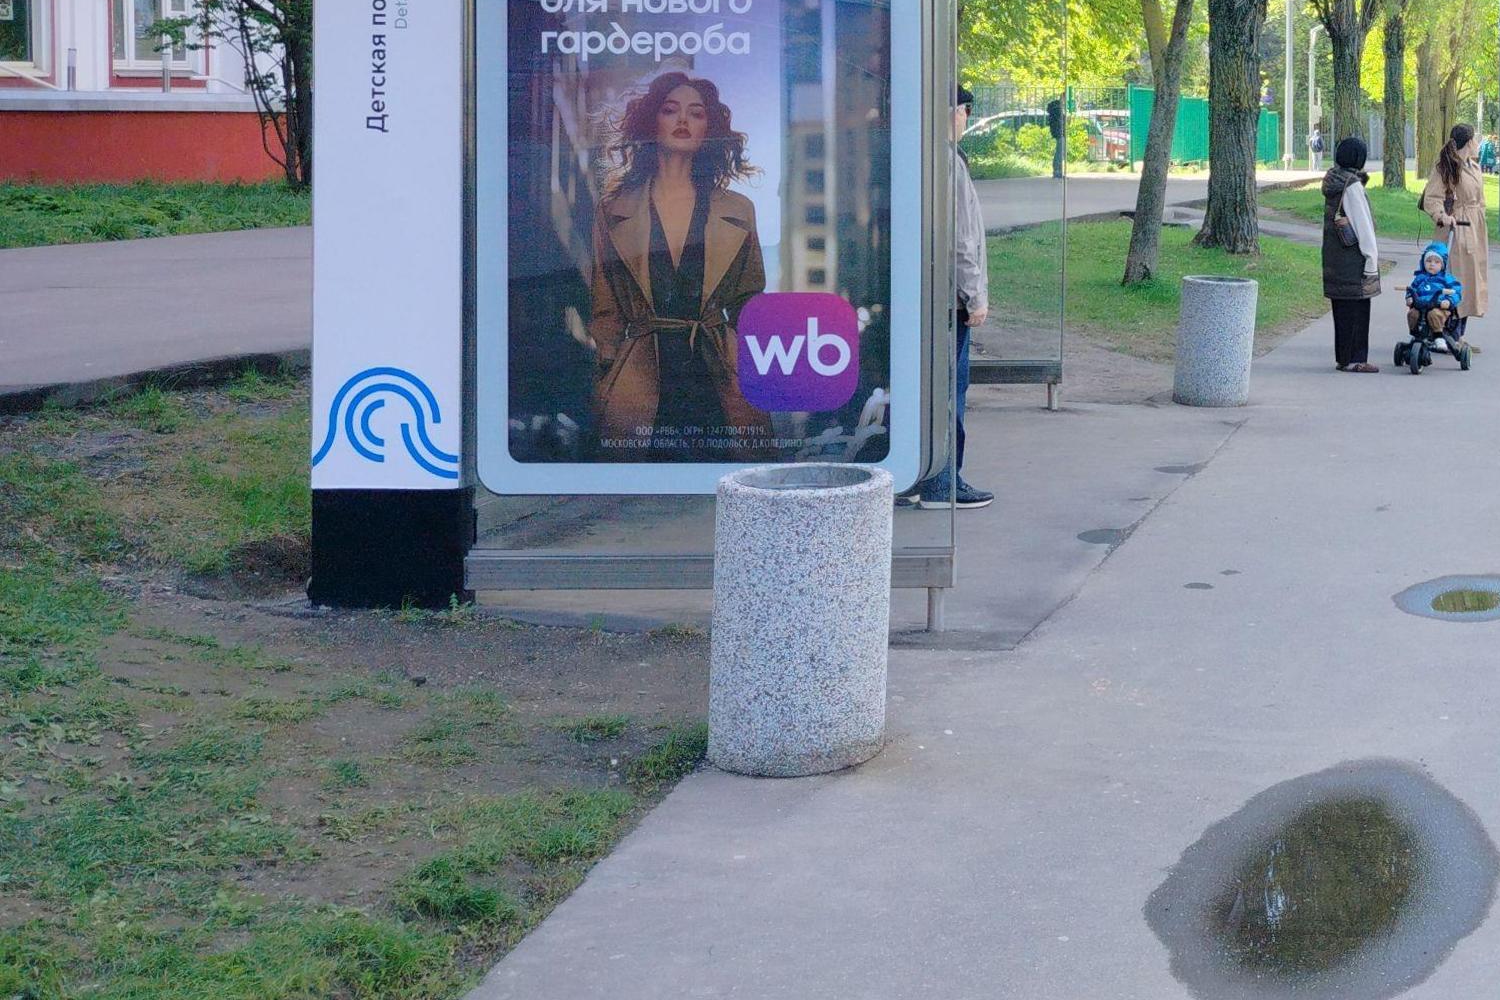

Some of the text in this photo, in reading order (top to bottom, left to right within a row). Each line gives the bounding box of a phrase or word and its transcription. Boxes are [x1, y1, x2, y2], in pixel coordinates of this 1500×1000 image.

[541, 22, 750, 62] гардероба
[366, 33, 389, 133] Детская
[744, 316, 851, 377] wb
[600, 439, 652, 449] МОСКОВСКАЯ
[635, 426, 654, 436] ООО
[683, 426, 704, 436] ОГРН
